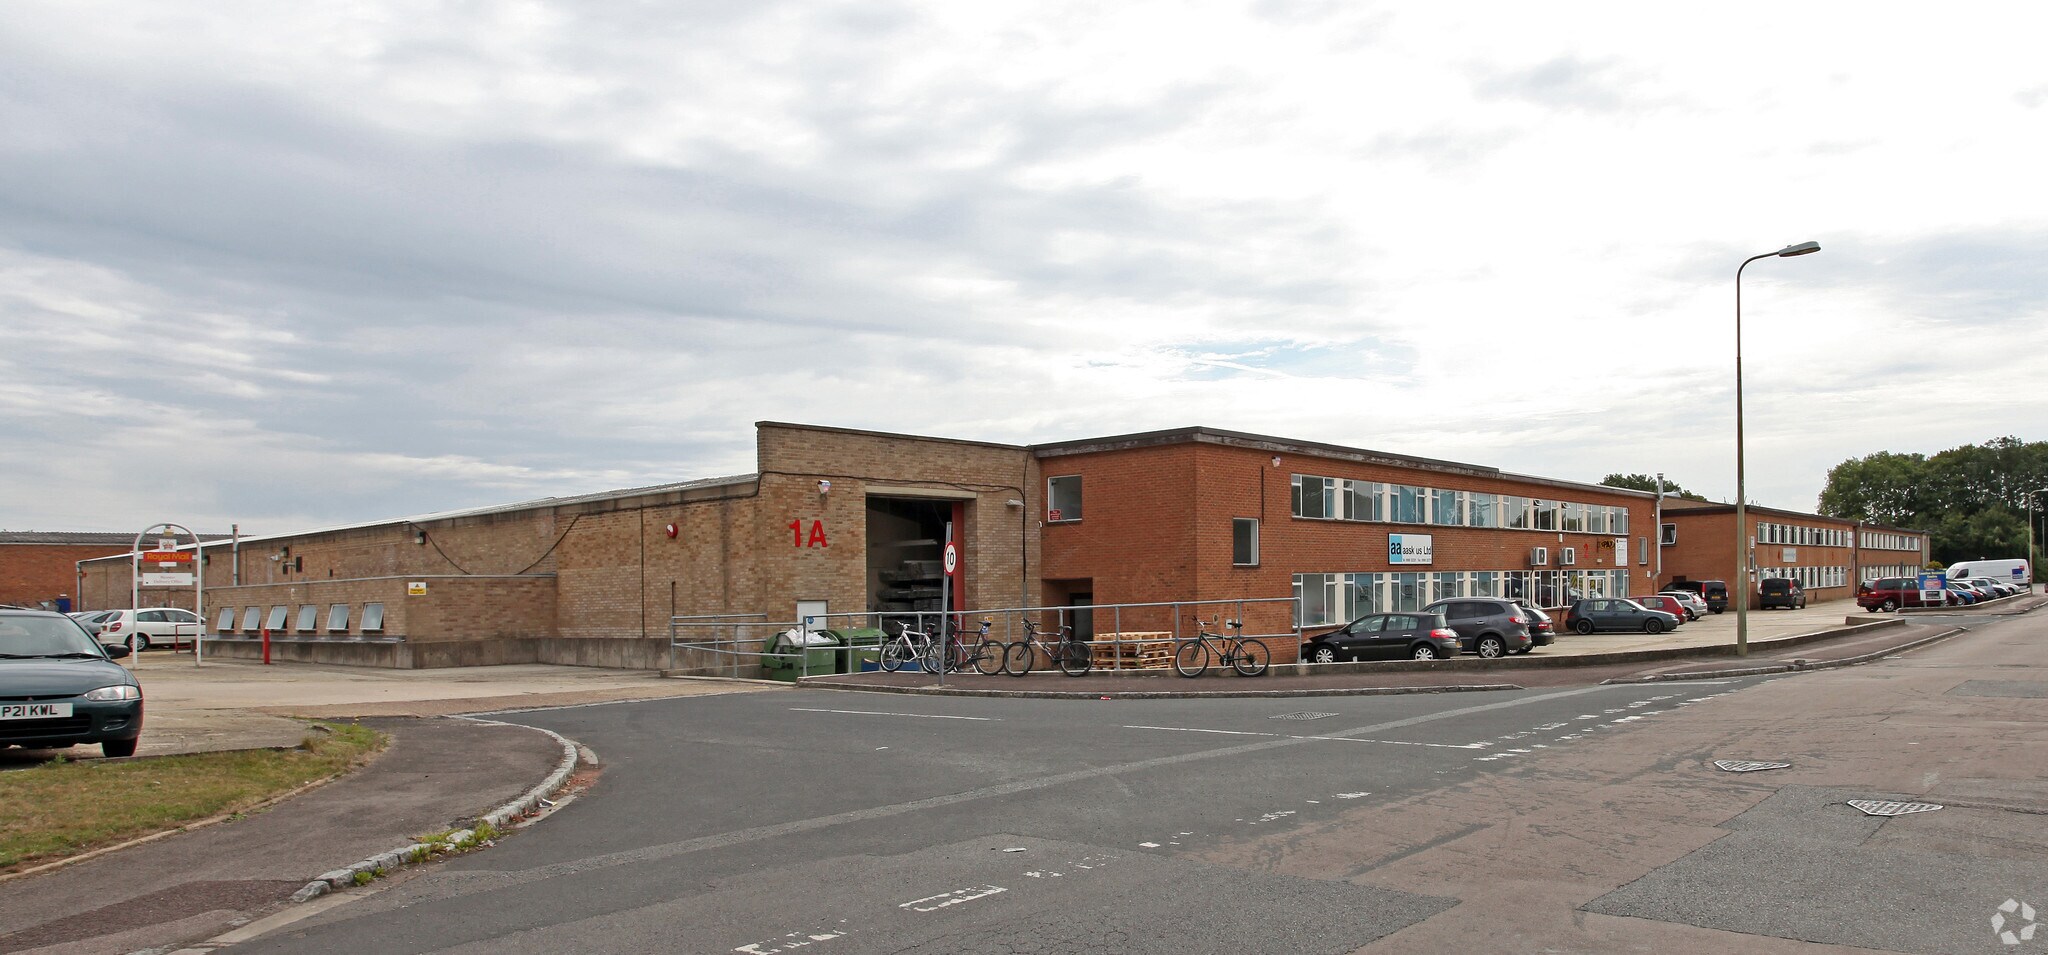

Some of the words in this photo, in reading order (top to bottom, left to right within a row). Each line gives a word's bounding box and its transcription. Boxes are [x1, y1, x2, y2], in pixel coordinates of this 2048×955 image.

[789, 519, 828, 548] 1A
[1390, 542, 1402, 554] aa
[1402, 546, 1415, 554] aask
[147, 552, 170, 561] Royal
[946, 552, 954, 566] 10
[2, 706, 26, 717] P21
[30, 705, 58, 716] KWL
